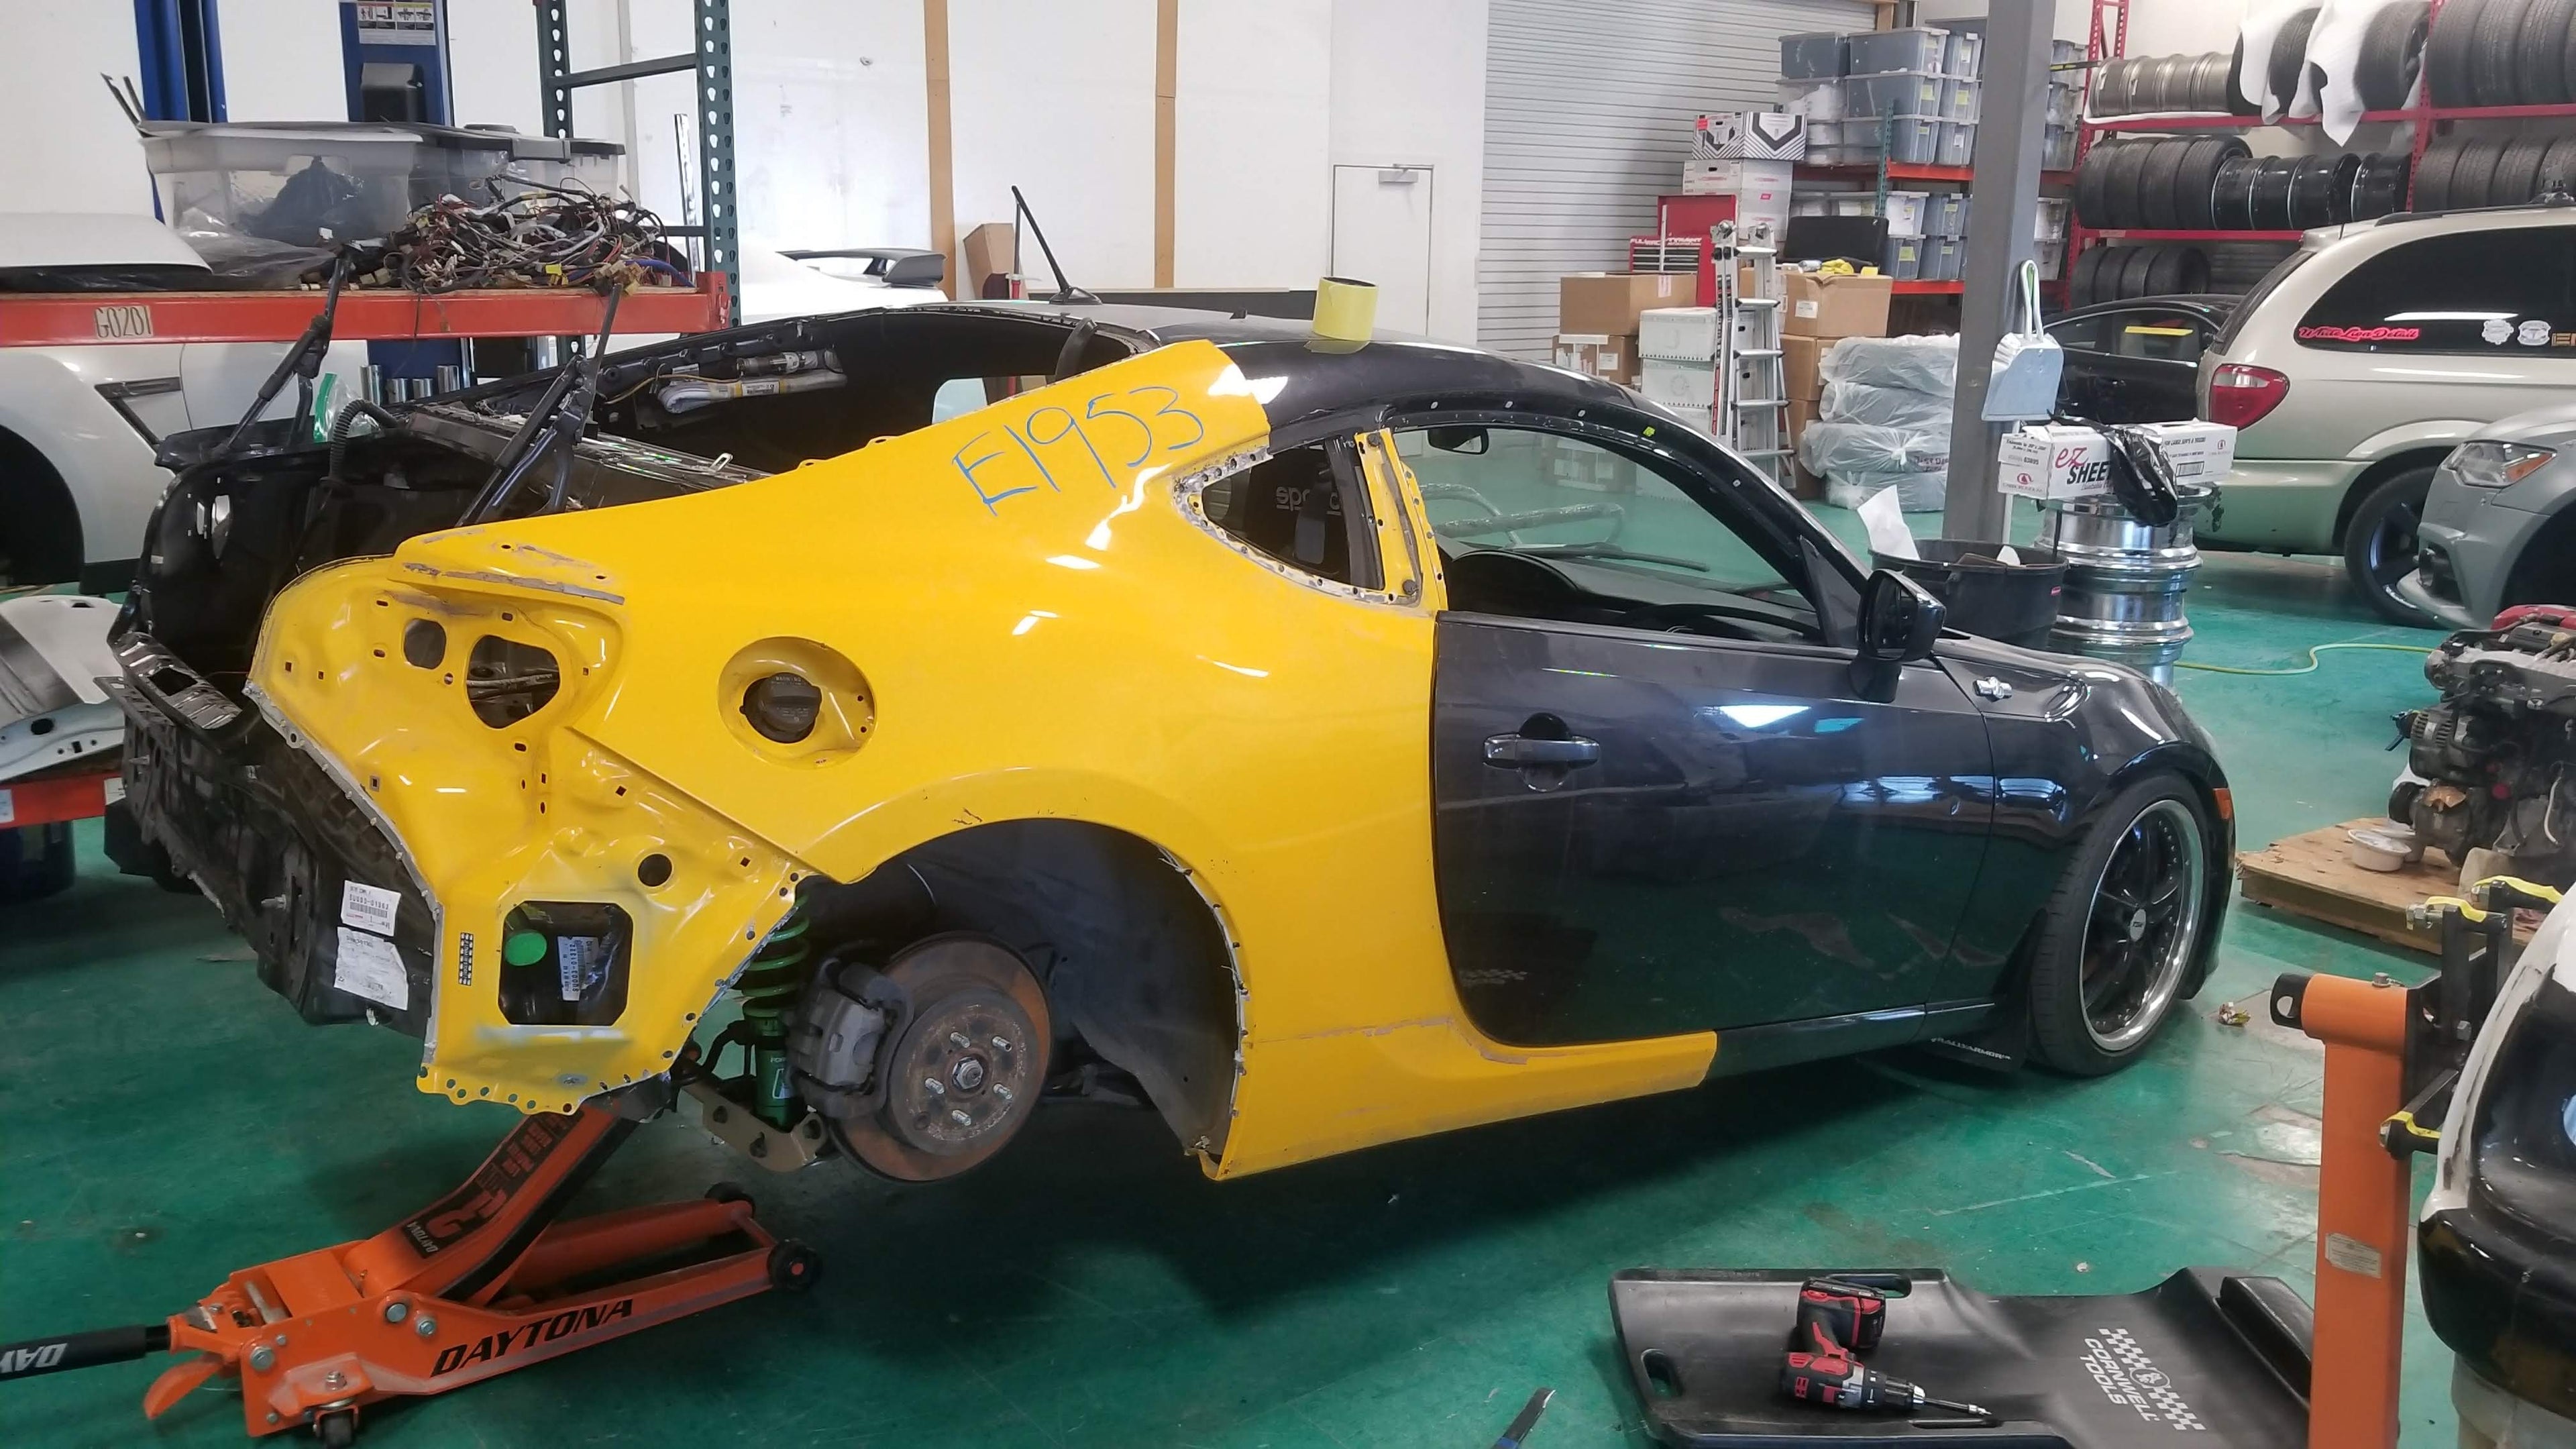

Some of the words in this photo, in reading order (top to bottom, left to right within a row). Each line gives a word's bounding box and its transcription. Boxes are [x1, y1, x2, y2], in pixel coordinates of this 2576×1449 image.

[952, 386, 1204, 517] E1953
[2055, 447, 2090, 468] ez
[407, 1221, 439, 1253] DAYTONA
[429, 1298, 634, 1379] DAYTONA
[2080, 1354, 2129, 1405] TOOLS
[2084, 1338, 2158, 1421] CORNWELL
